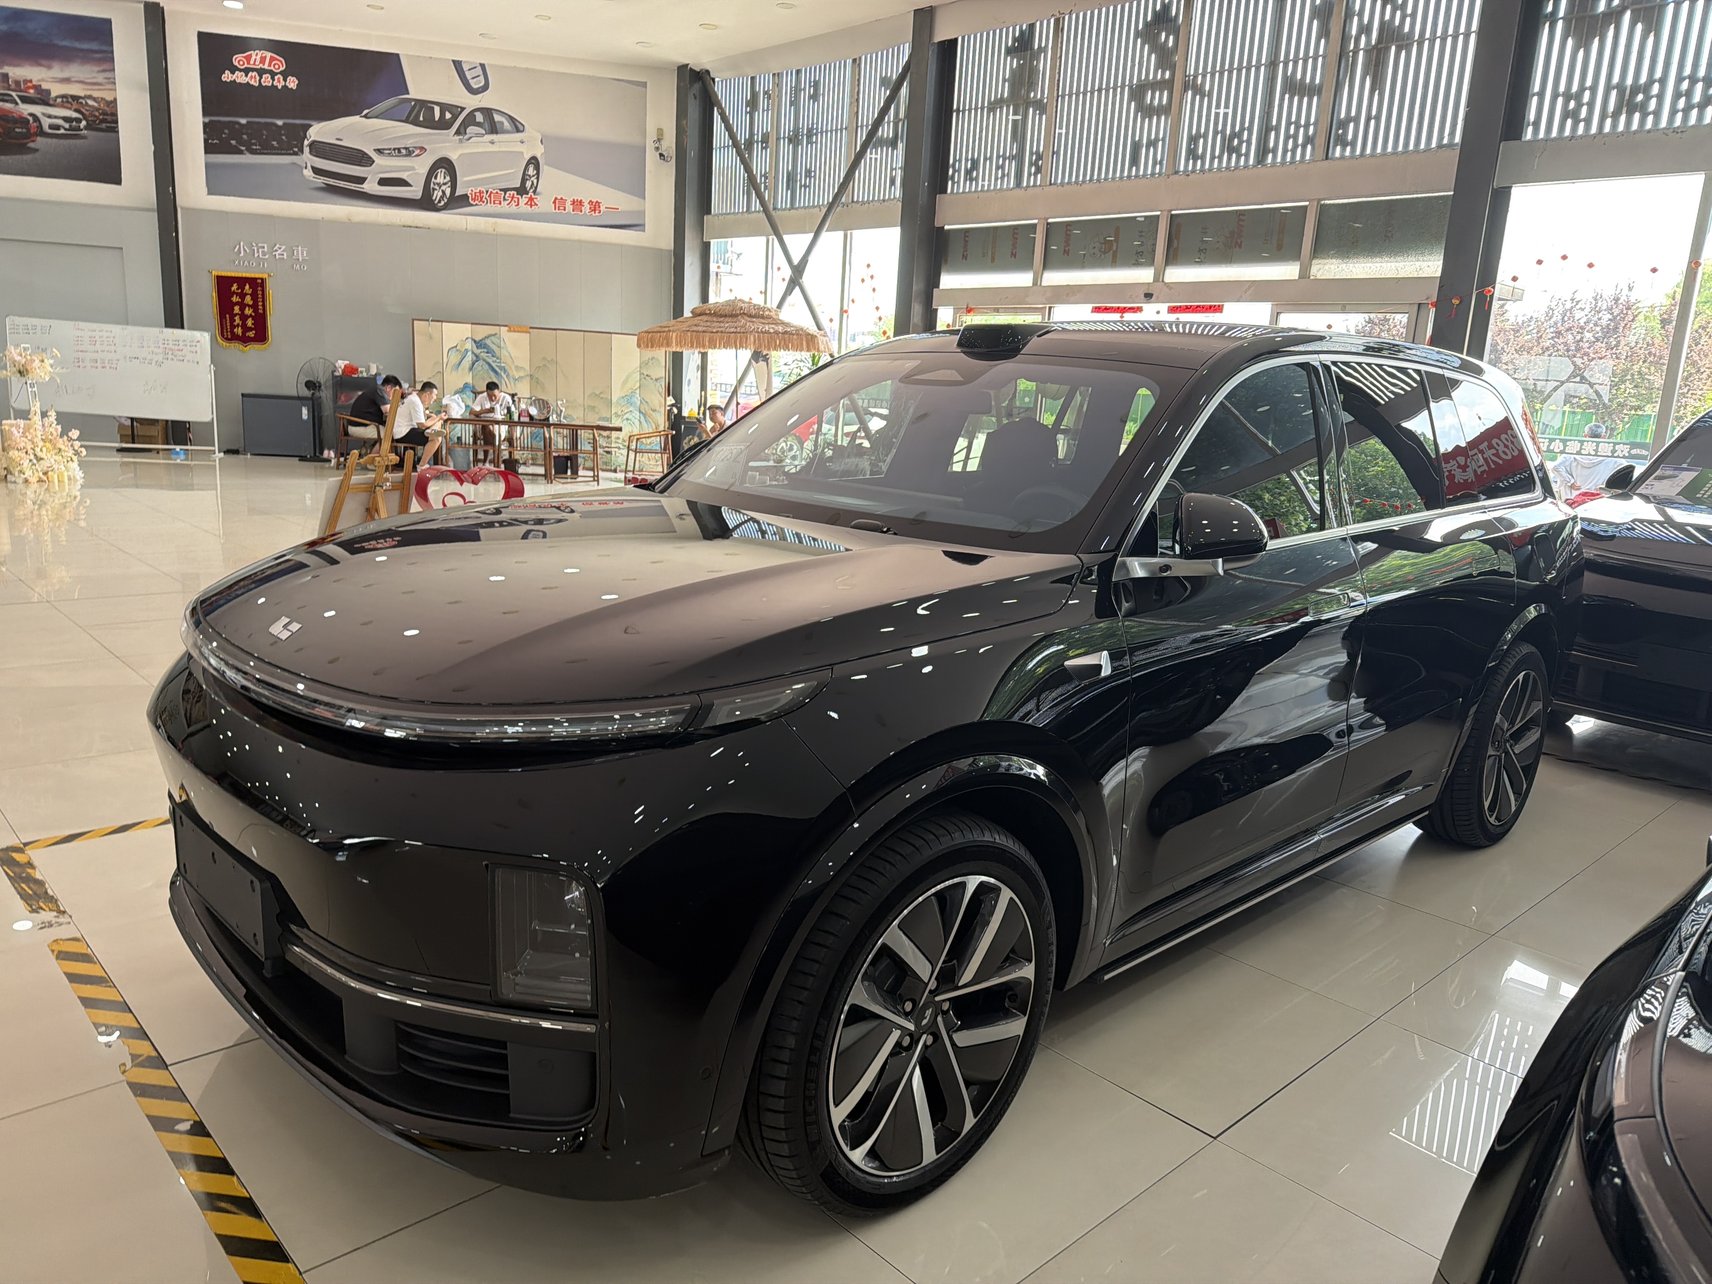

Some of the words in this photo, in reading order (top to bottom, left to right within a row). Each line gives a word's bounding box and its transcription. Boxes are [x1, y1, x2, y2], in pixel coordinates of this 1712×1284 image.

[221, 70, 299, 90] 小记精品车行
[467, 187, 540, 209] 诚信为本
[552, 196, 620, 215] 信誉第一
[234, 241, 309, 261] 小记名車
[234, 259, 256, 268] XIAO
